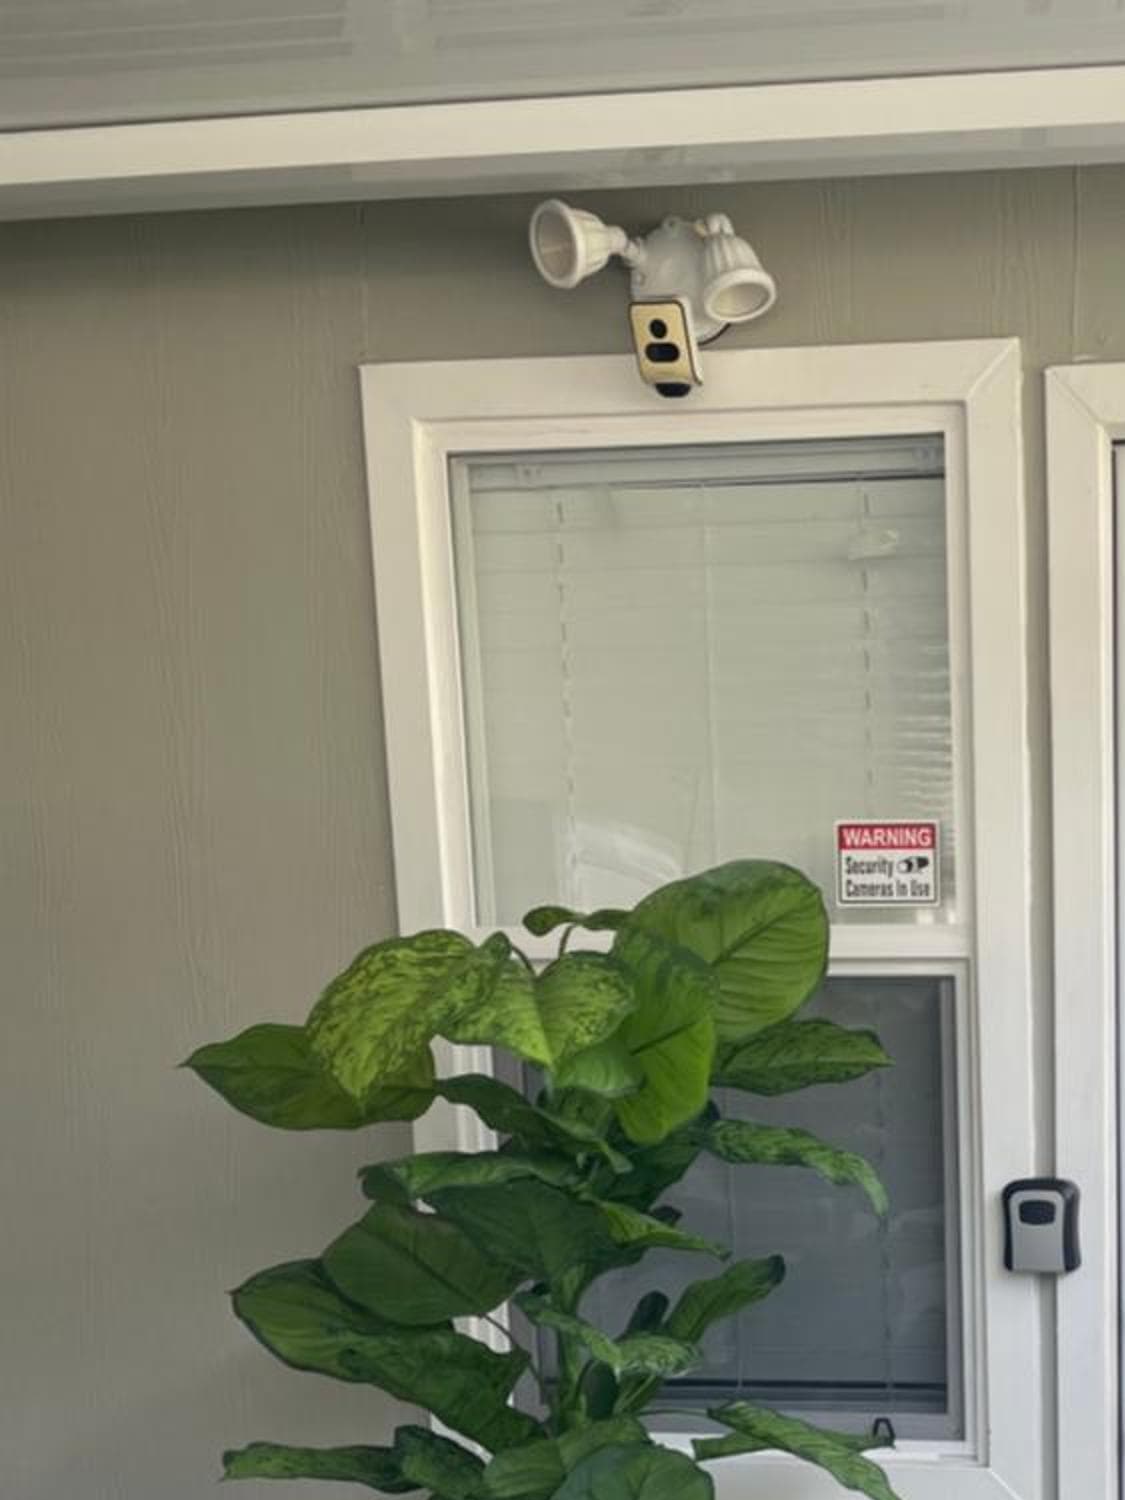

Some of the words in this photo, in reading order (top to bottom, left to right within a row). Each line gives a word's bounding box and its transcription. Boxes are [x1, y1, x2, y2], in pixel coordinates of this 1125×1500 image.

[842, 826, 932, 847] WARNING
[846, 856, 894, 878] Security
[846, 879, 894, 897] Cameras
[910, 879, 930, 897] Use
